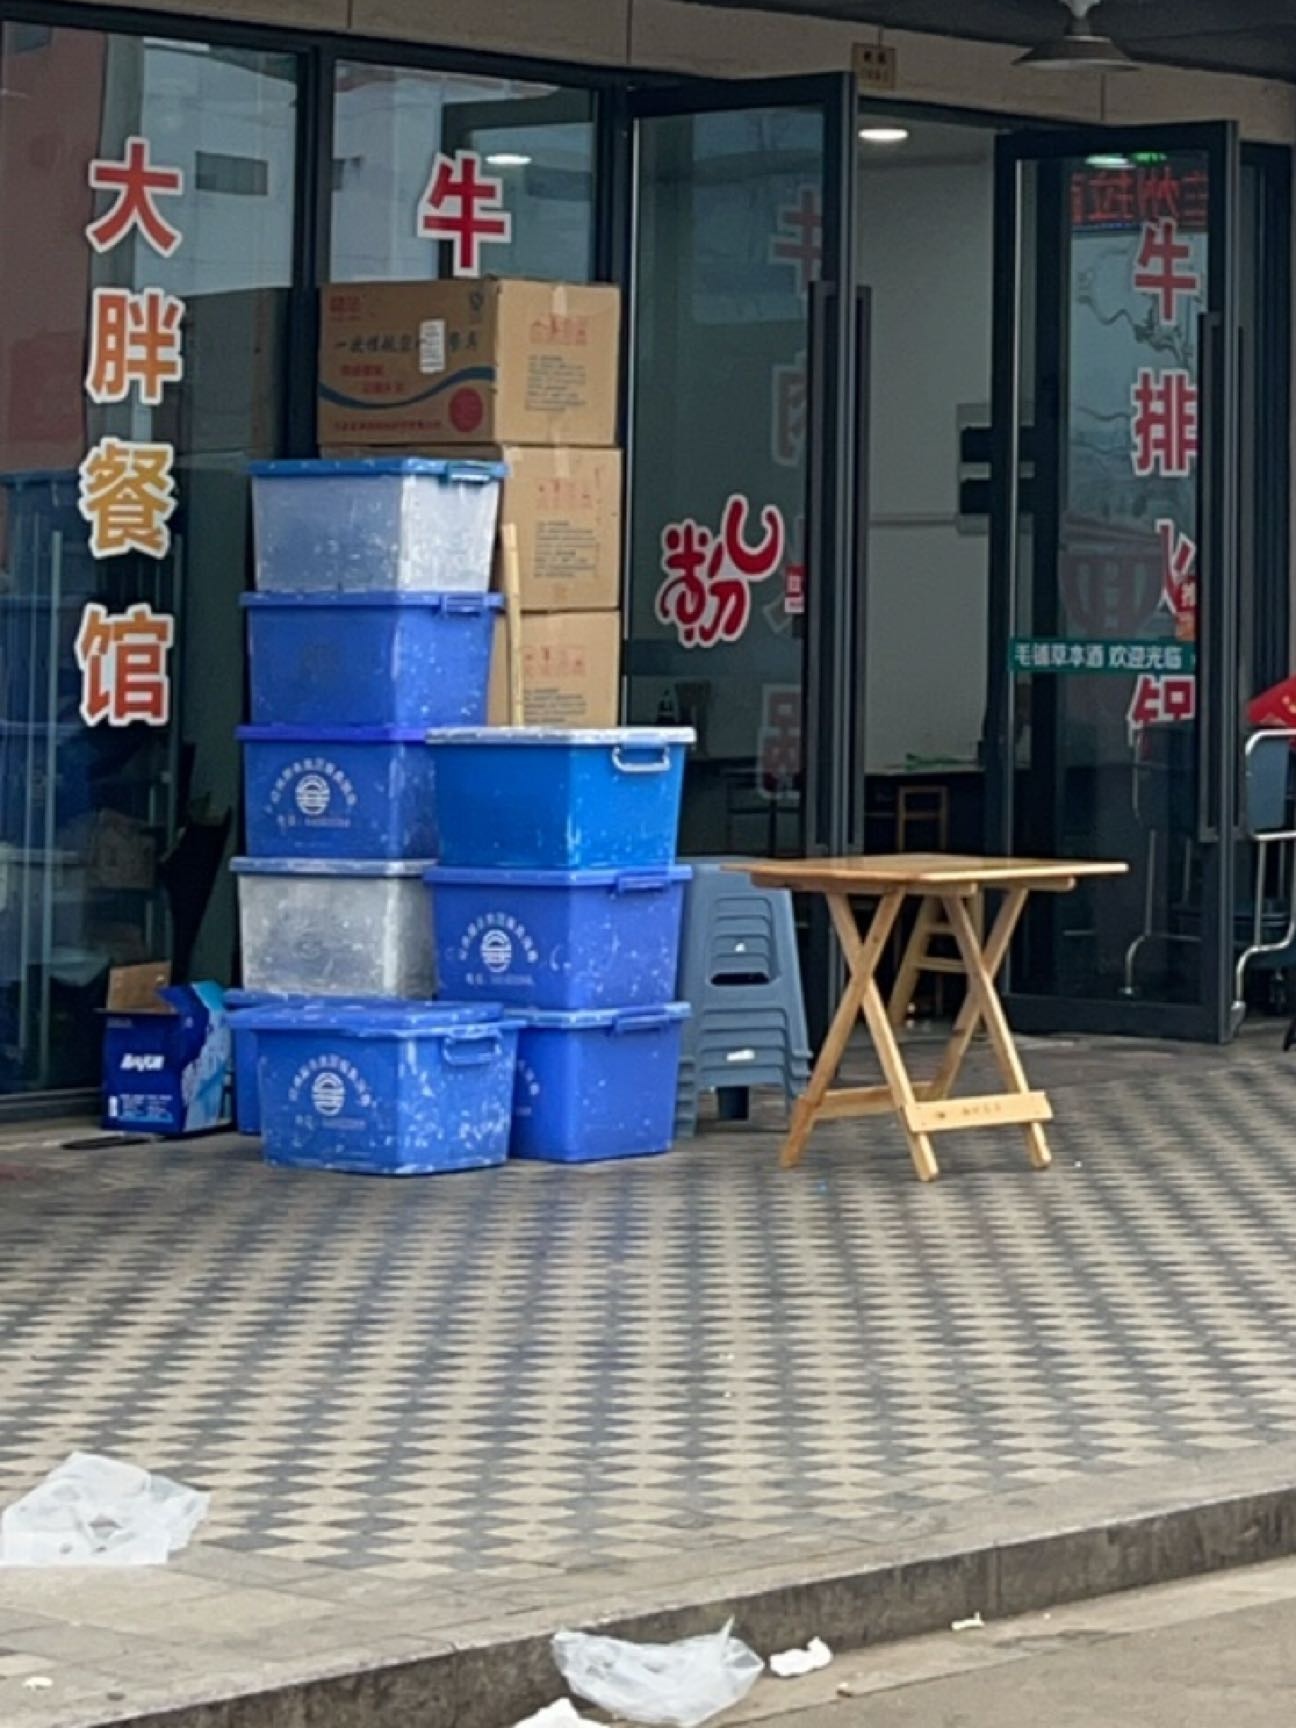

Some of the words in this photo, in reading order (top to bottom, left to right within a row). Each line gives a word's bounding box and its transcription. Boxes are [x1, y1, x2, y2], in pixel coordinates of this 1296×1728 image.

[78, 136, 187, 725] 大胖餐馆
[1108, 645, 1183, 670] 欢迎光临
